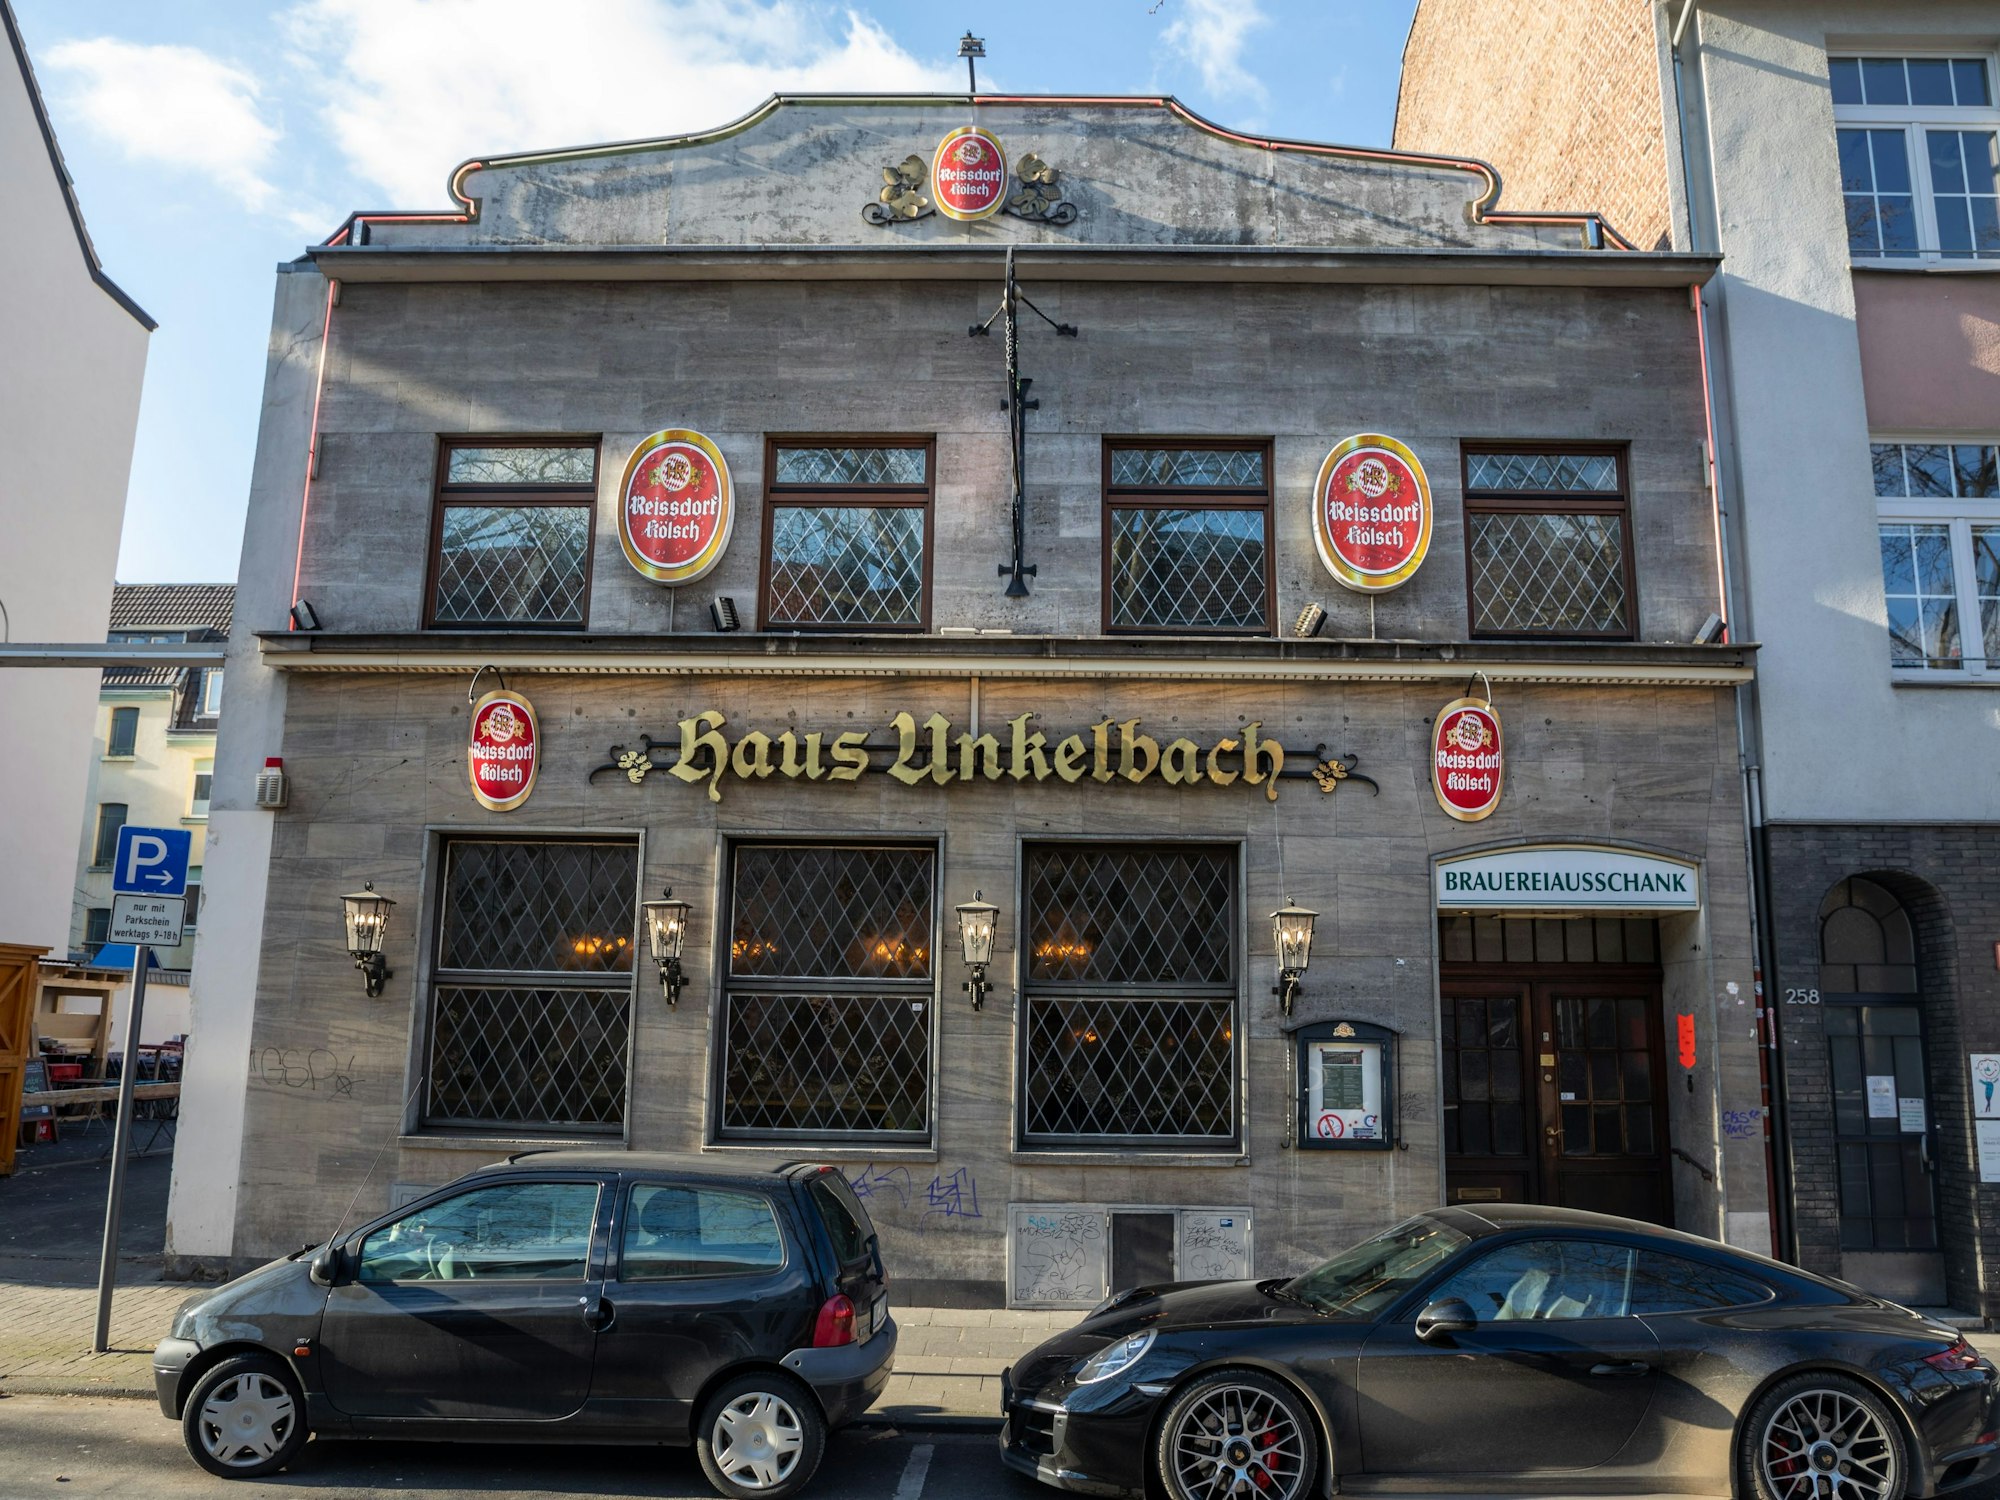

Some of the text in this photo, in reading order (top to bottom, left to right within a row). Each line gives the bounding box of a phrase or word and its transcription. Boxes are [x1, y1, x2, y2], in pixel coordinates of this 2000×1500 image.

[940, 168, 1001, 182] Reissdorf
[951, 183, 989, 197] Kölsch
[629, 495, 720, 517] Reissdorf
[1329, 500, 1419, 522] Reissdorf
[644, 519, 700, 542] Kölsch
[1345, 525, 1403, 549] Kölsch
[473, 741, 534, 760] Reissdorf
[668, 710, 1285, 803] Haus Unkelbach
[1437, 750, 1500, 769] Reissdorf
[480, 762, 522, 784] Kölsch
[1446, 771, 1491, 793] Kölsch
[126, 835, 168, 884] P
[1444, 871, 1687, 893] BRAUEREIAUSSCHANK
[133, 904, 165, 913] nur mit
[125, 915, 170, 926] Parkschein
[114, 929, 150, 940] werktags
[1785, 988, 1820, 1005] 258
